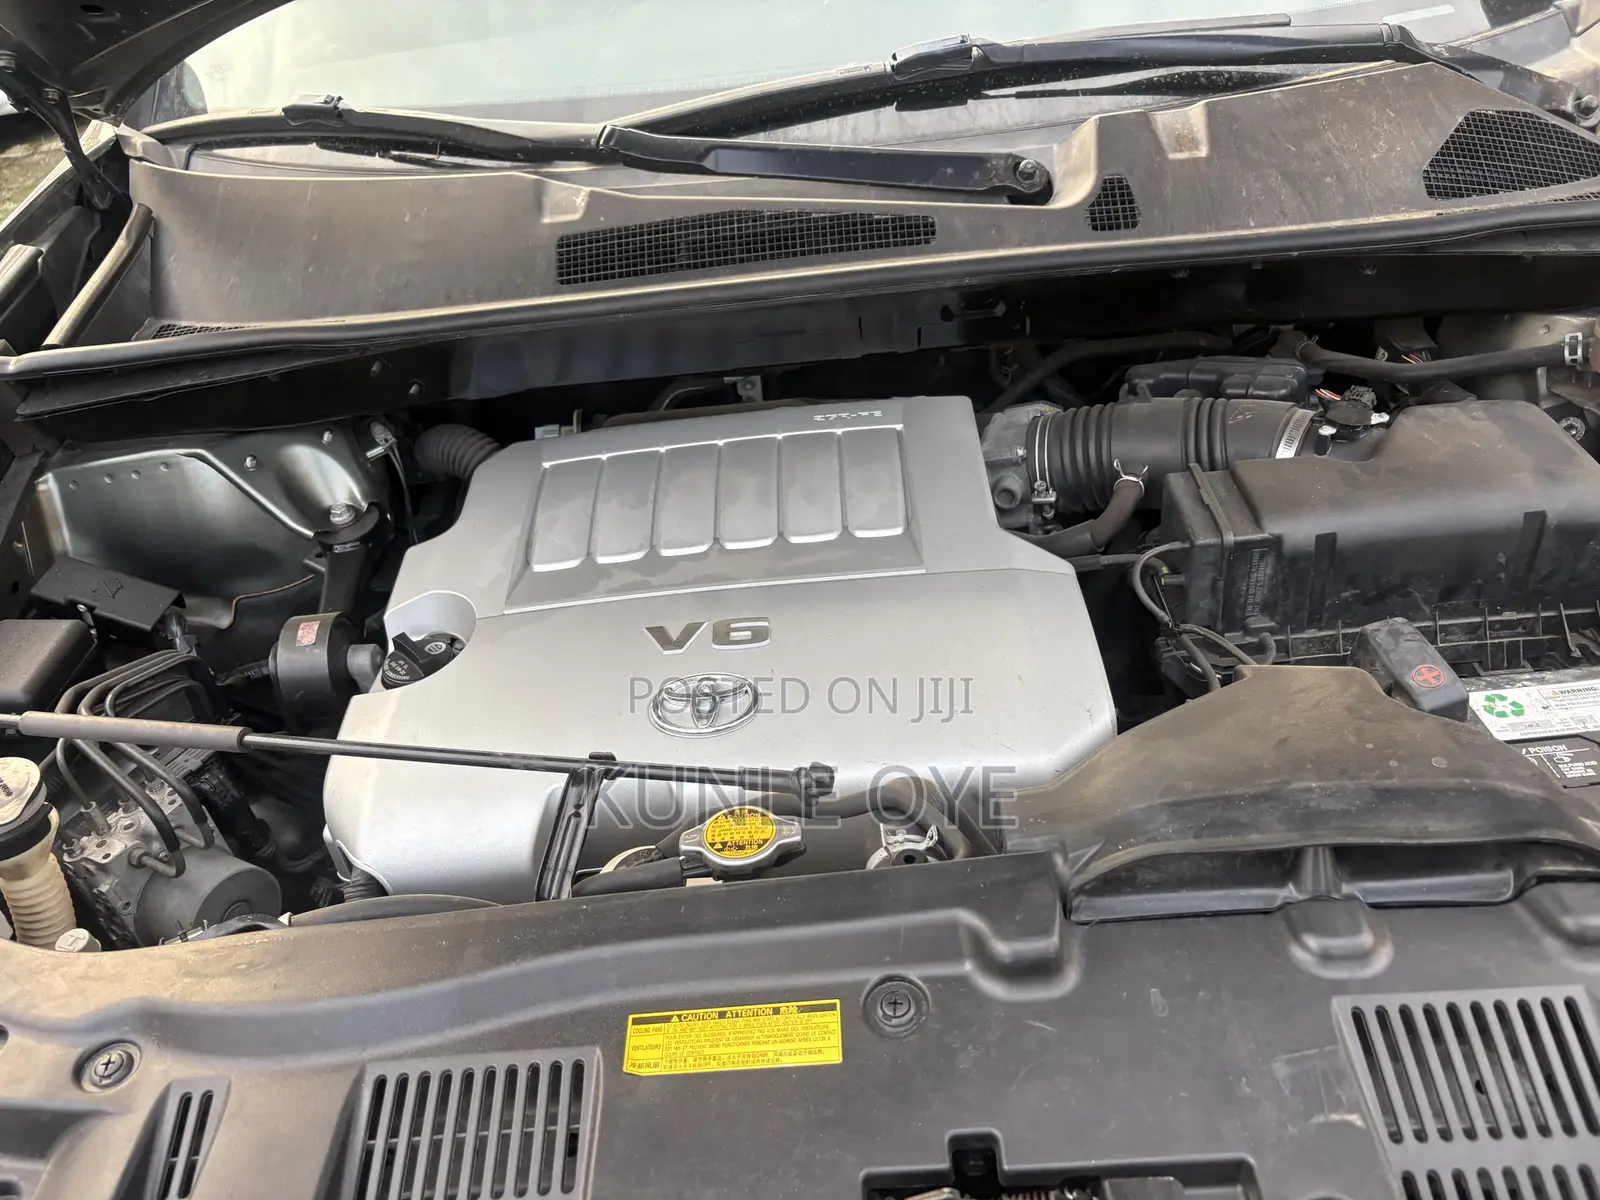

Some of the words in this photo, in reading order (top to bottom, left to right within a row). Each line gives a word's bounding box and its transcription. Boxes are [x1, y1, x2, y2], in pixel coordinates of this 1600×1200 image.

[643, 617, 770, 654] V6
[681, 1012, 719, 1022] CAUTION
[725, 1008, 773, 1018] ATTENTION
